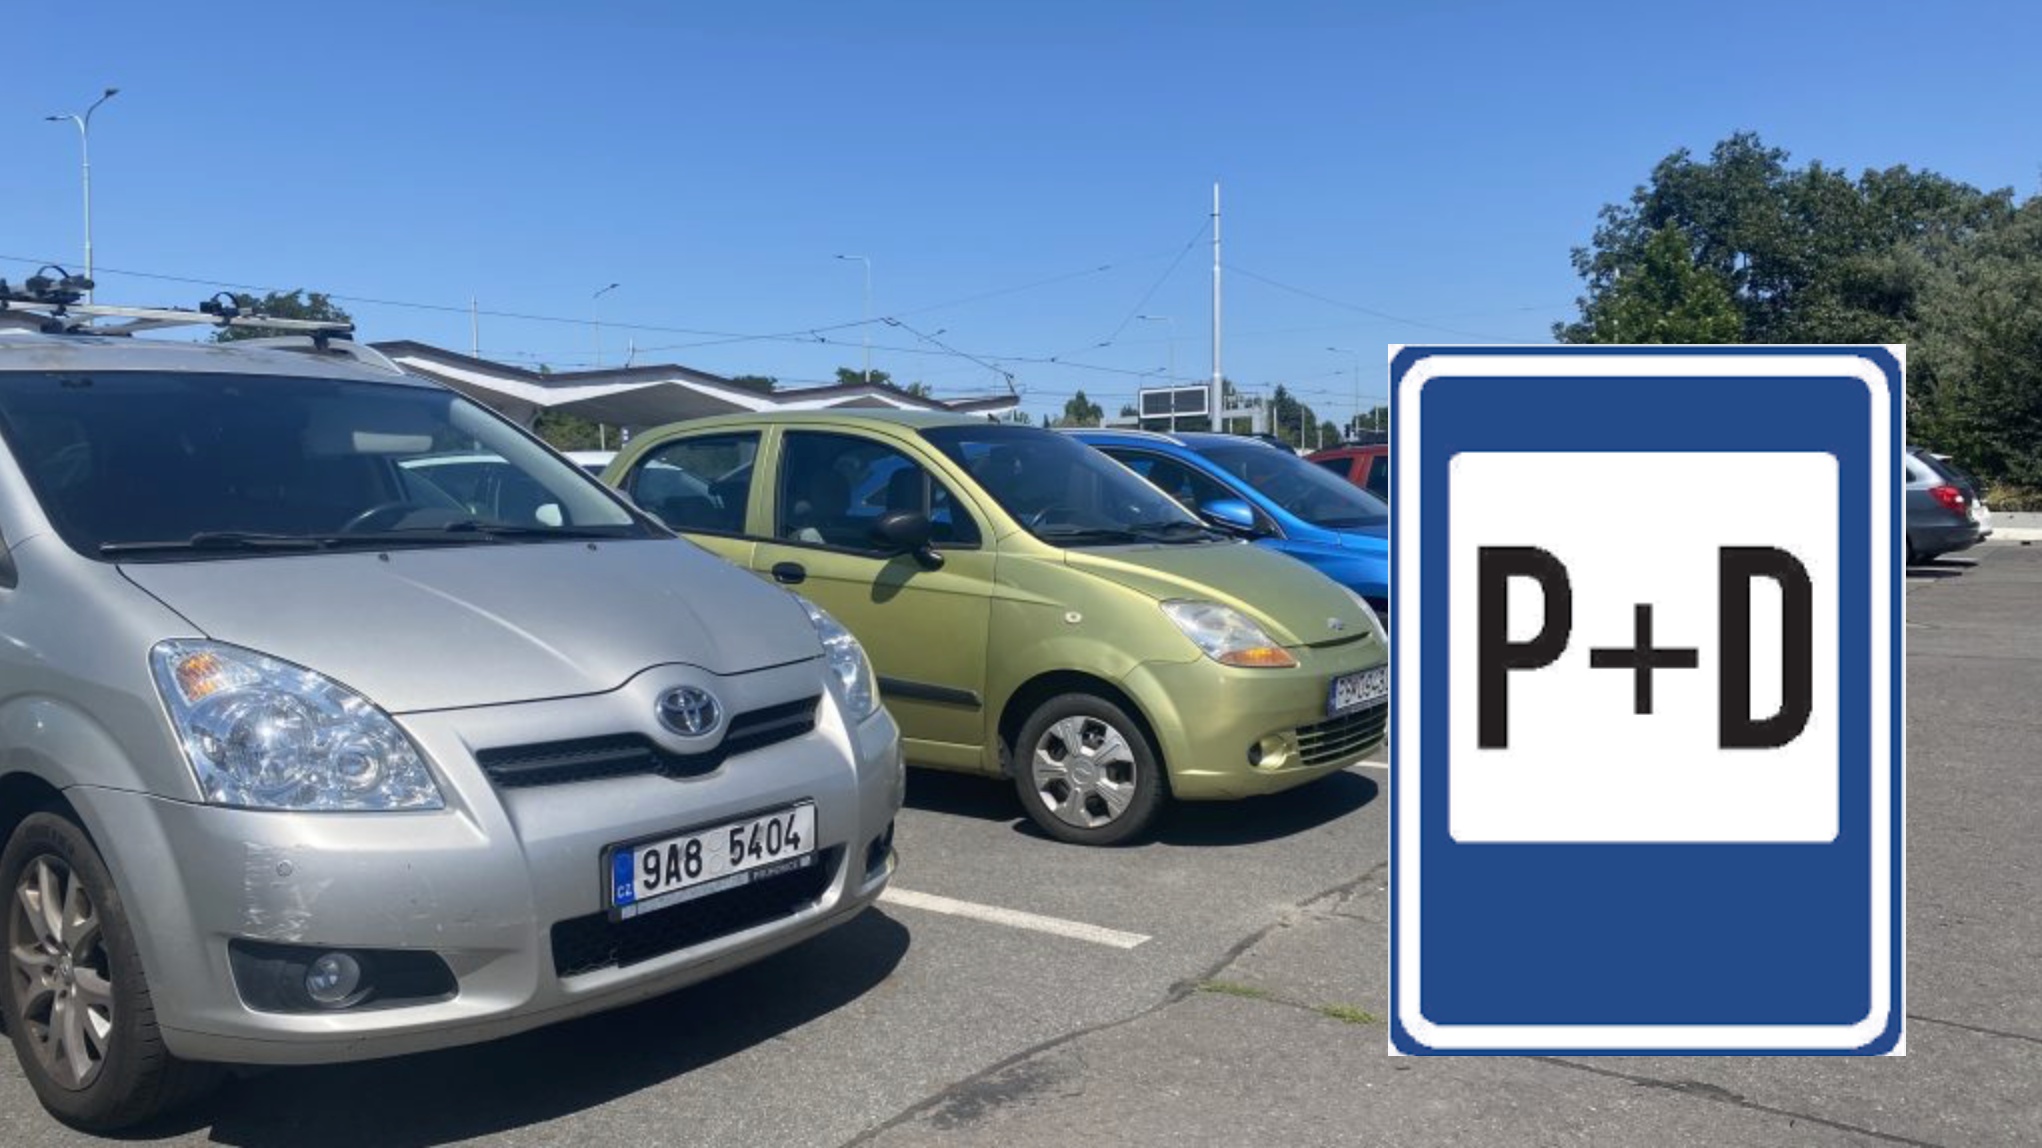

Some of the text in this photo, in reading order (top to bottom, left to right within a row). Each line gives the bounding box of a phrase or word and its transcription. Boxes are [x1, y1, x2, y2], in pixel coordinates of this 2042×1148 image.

[642, 814, 801, 891] 9A8 5404
[617, 884, 633, 899] CZ
